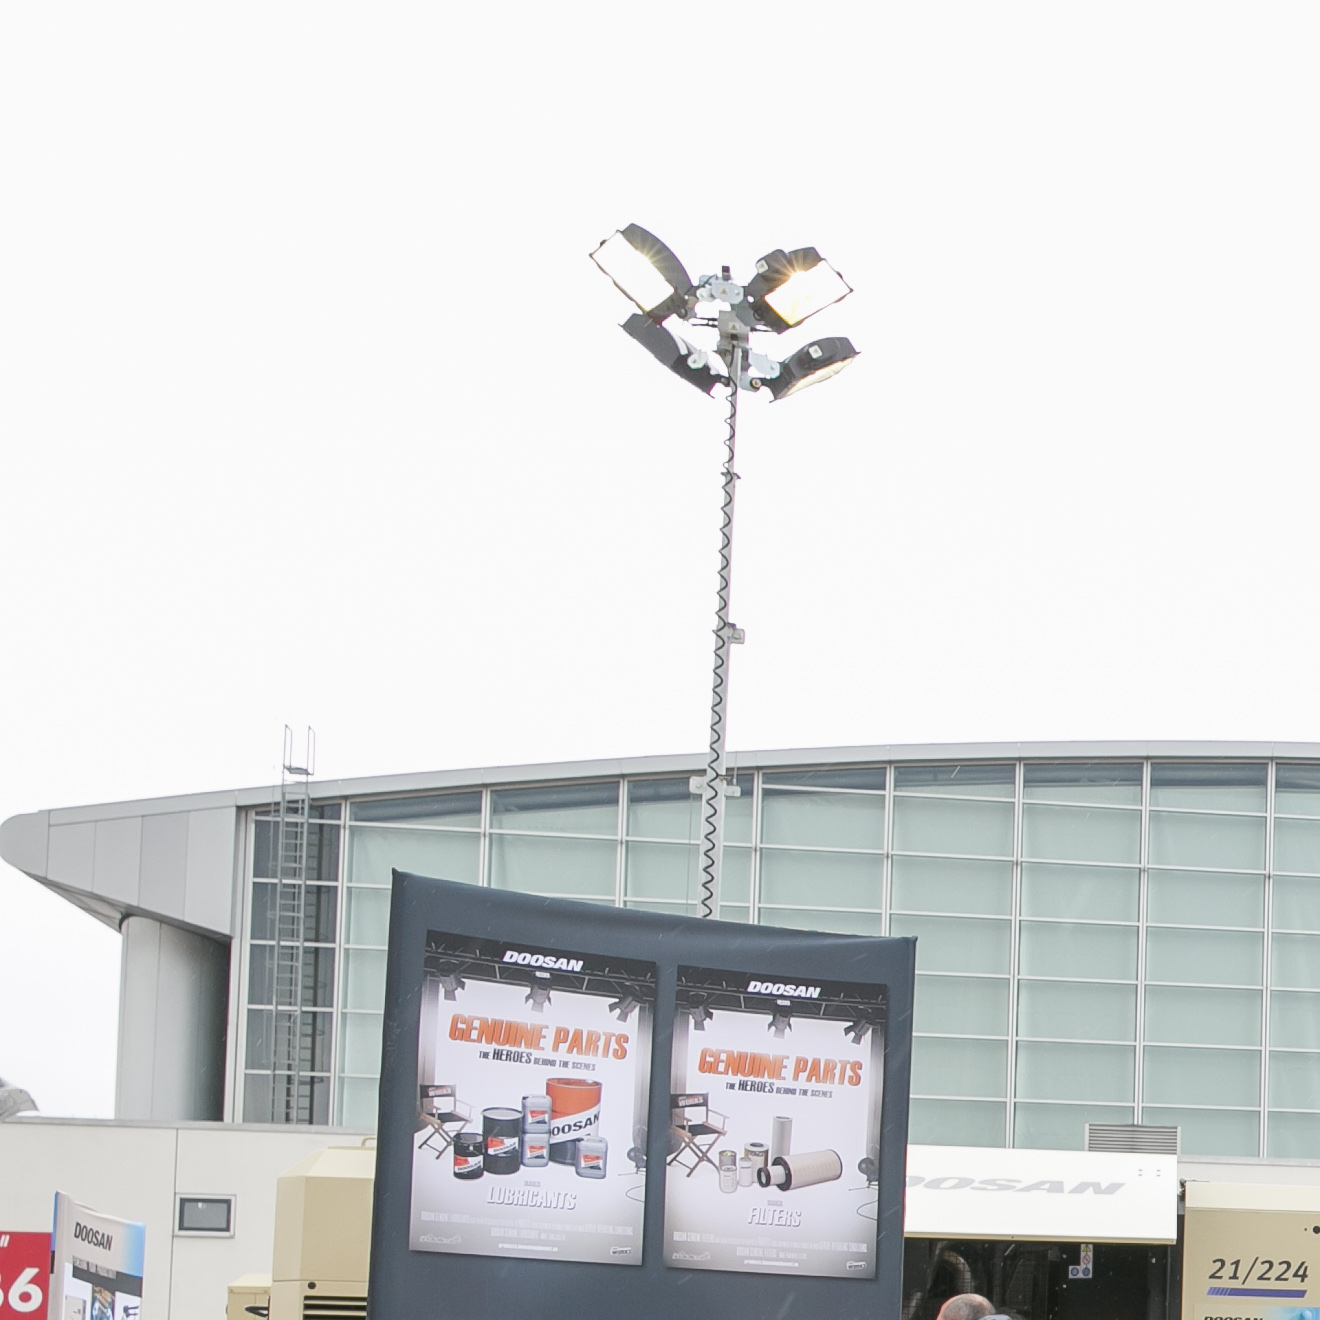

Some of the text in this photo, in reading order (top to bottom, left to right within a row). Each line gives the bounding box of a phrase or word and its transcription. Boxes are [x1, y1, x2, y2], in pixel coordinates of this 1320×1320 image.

[503, 950, 583, 971] DOOSAN
[747, 980, 821, 998] DOOSAN
[449, 1013, 630, 1060] GENUINE PARTS
[492, 1048, 532, 1065] HEROES
[571, 1061, 597, 1072] SCENES
[698, 1048, 863, 1087] GENUINE PARTS
[738, 1079, 775, 1094] HEROES
[810, 1089, 833, 1099] SCENES
[486, 1187, 578, 1210] LUBRICANTS
[748, 1207, 803, 1228] FILTERS
[74, 1221, 113, 1251] DOOSAN
[1208, 1256, 1308, 1285] 21/224
[0, 1267, 43, 1313] 6
